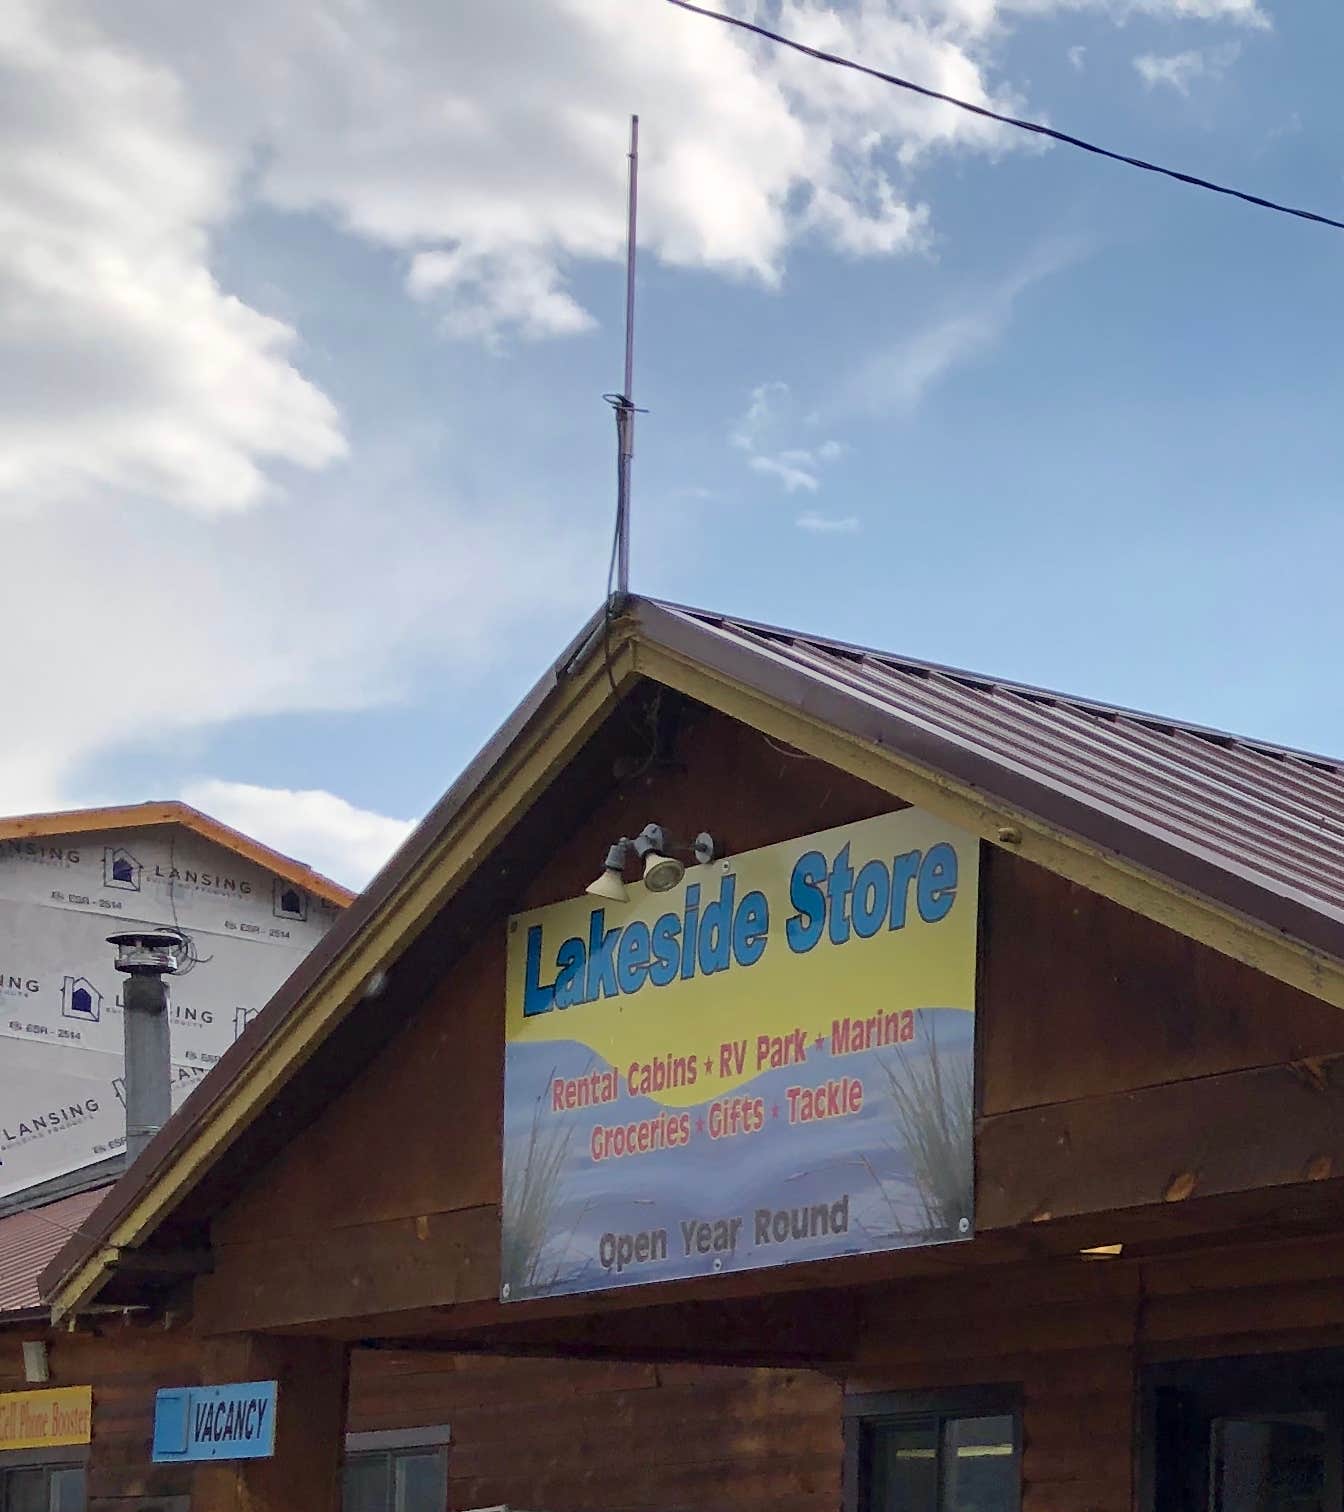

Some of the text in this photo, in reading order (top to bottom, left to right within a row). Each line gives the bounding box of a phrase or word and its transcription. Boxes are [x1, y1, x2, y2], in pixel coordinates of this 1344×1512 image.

[155, 864, 252, 894] LANSING
[523, 840, 959, 1018] Lakeside Store
[552, 1008, 914, 1113] Rental Cabins RV Park Marina
[3, 1098, 99, 1141] LANSING
[590, 1077, 864, 1162] Groceries Gifts Tackle
[600, 1194, 849, 1273] Open Year Round
[194, 1398, 268, 1442] VACANCY
